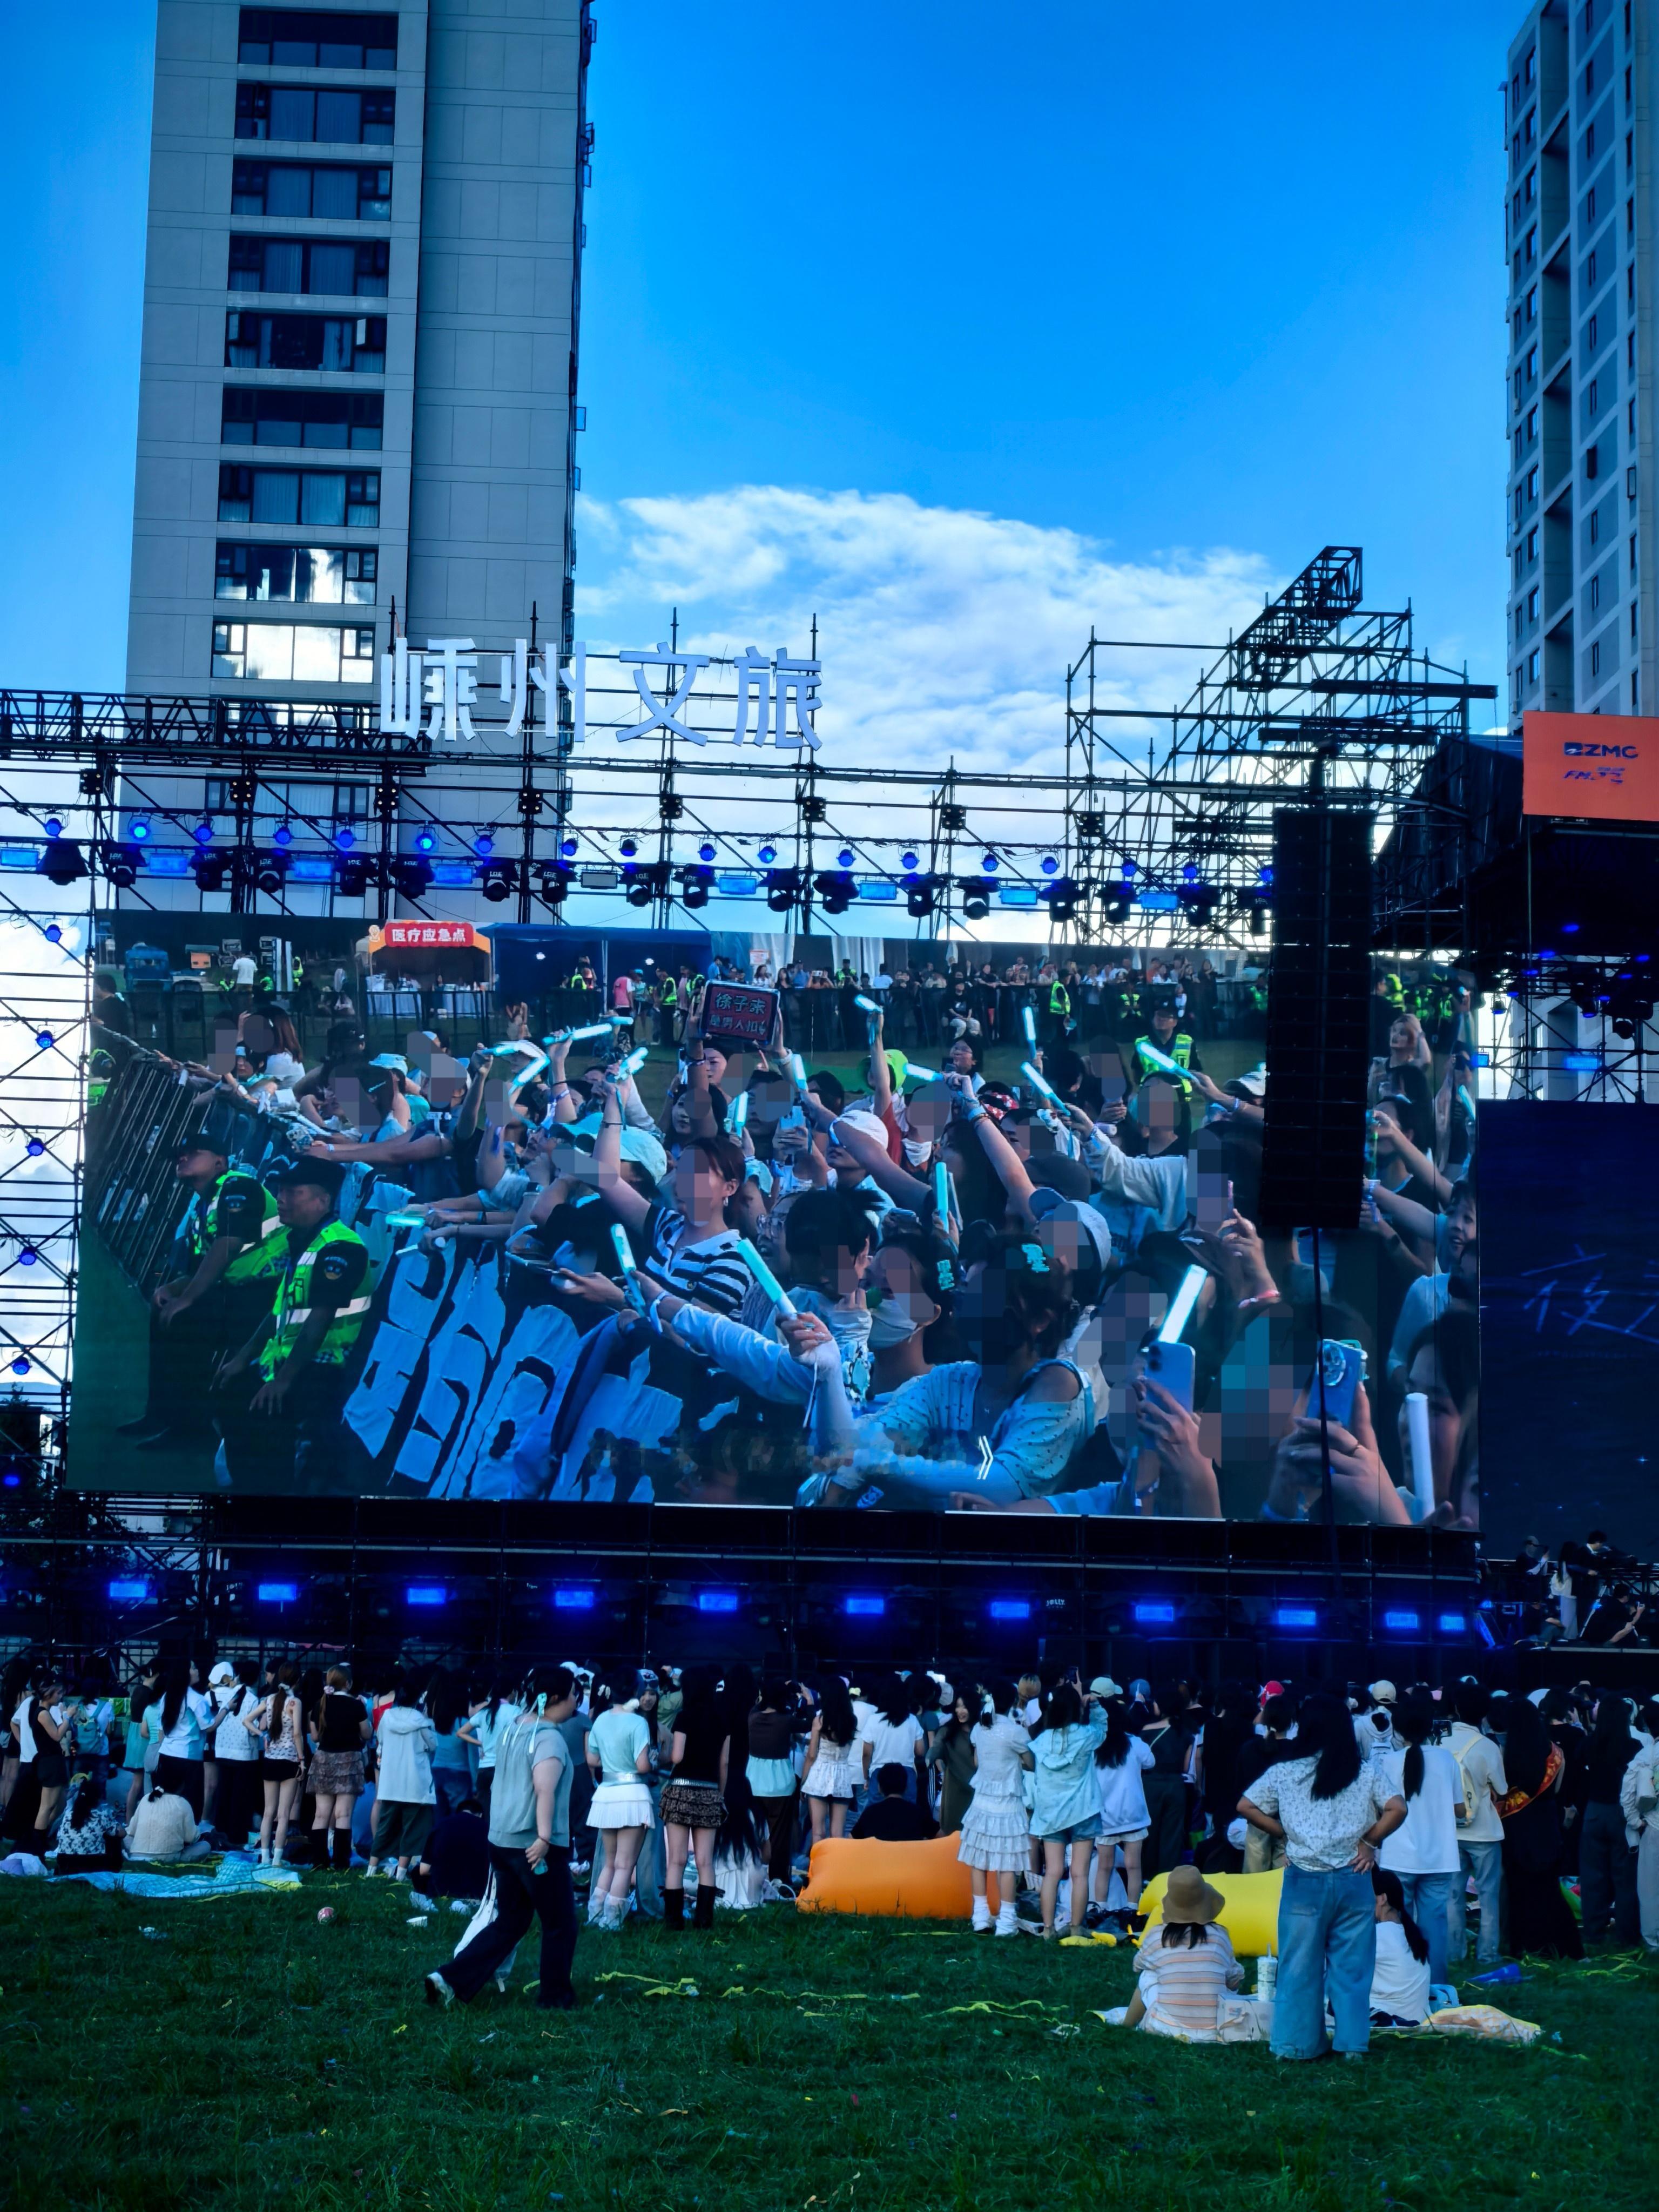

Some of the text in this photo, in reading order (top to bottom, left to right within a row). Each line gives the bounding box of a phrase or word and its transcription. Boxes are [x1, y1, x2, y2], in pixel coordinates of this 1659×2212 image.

[380, 637, 822, 751] 嵊州文旅
[1583, 743, 1639, 759] ZMC
[392, 928, 466, 942] 医疗应急点
